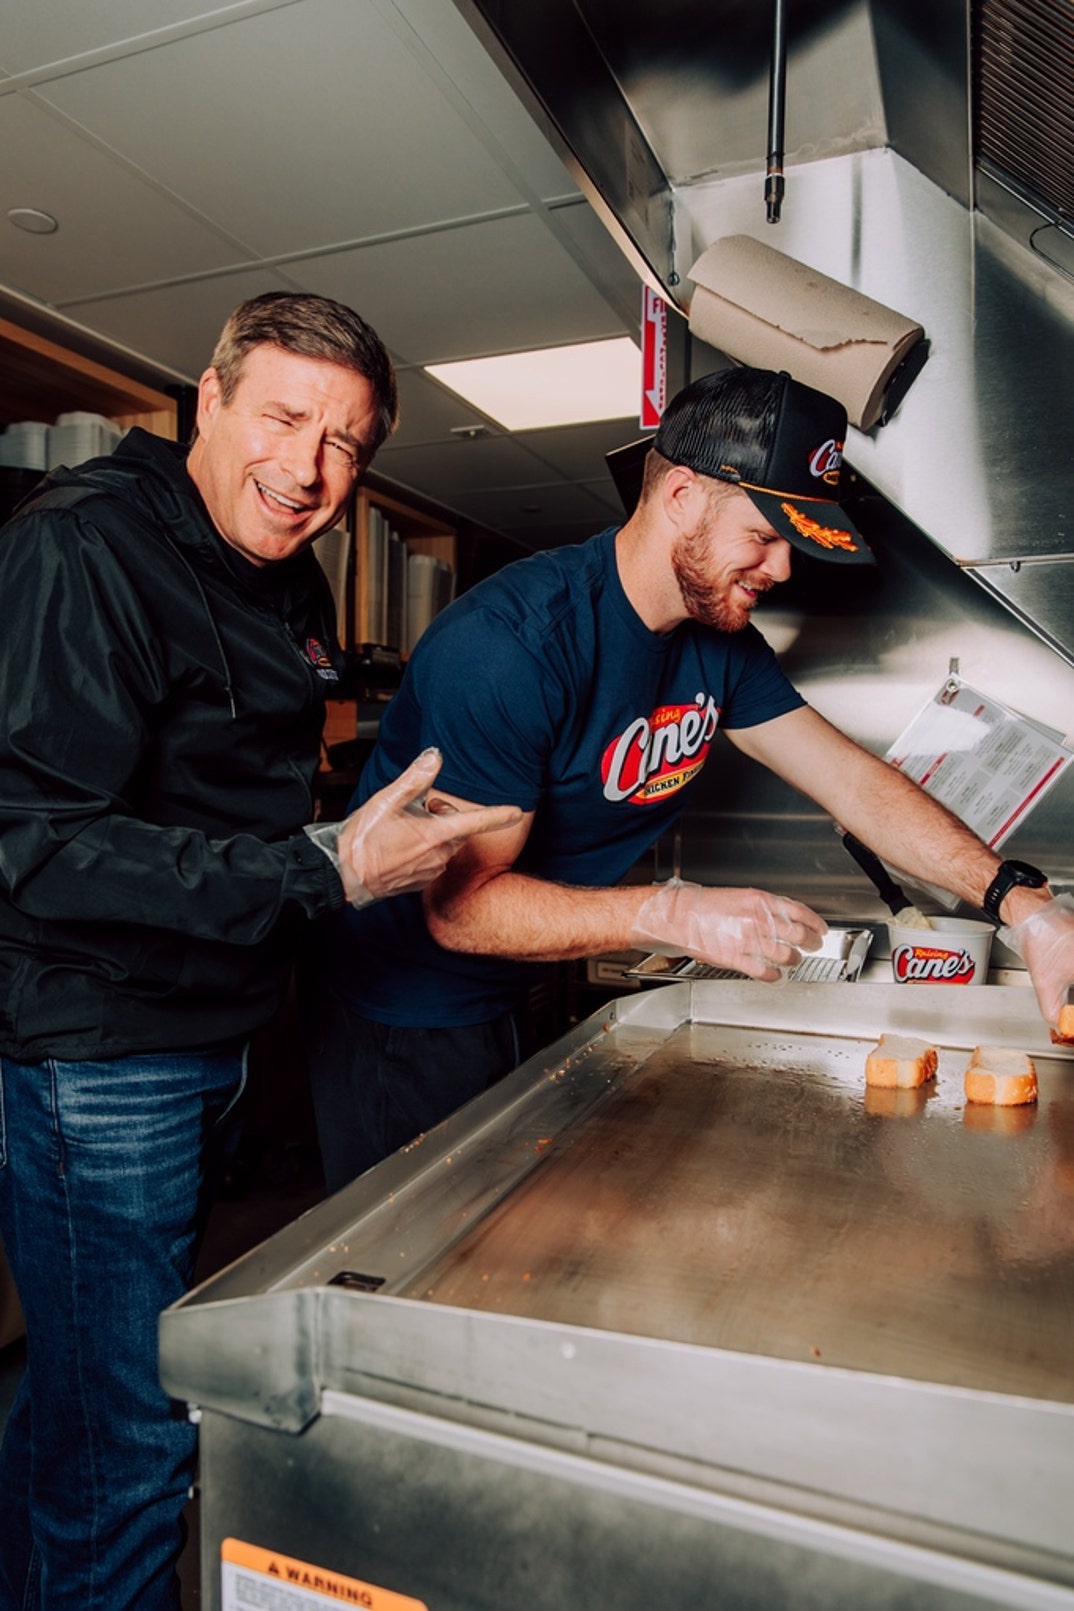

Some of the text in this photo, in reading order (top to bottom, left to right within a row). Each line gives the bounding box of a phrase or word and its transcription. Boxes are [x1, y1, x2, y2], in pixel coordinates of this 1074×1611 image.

[645, 776, 680, 796] HICKEN
[893, 943, 975, 983] Cane's
[286, 1566, 373, 1606] WARNING
